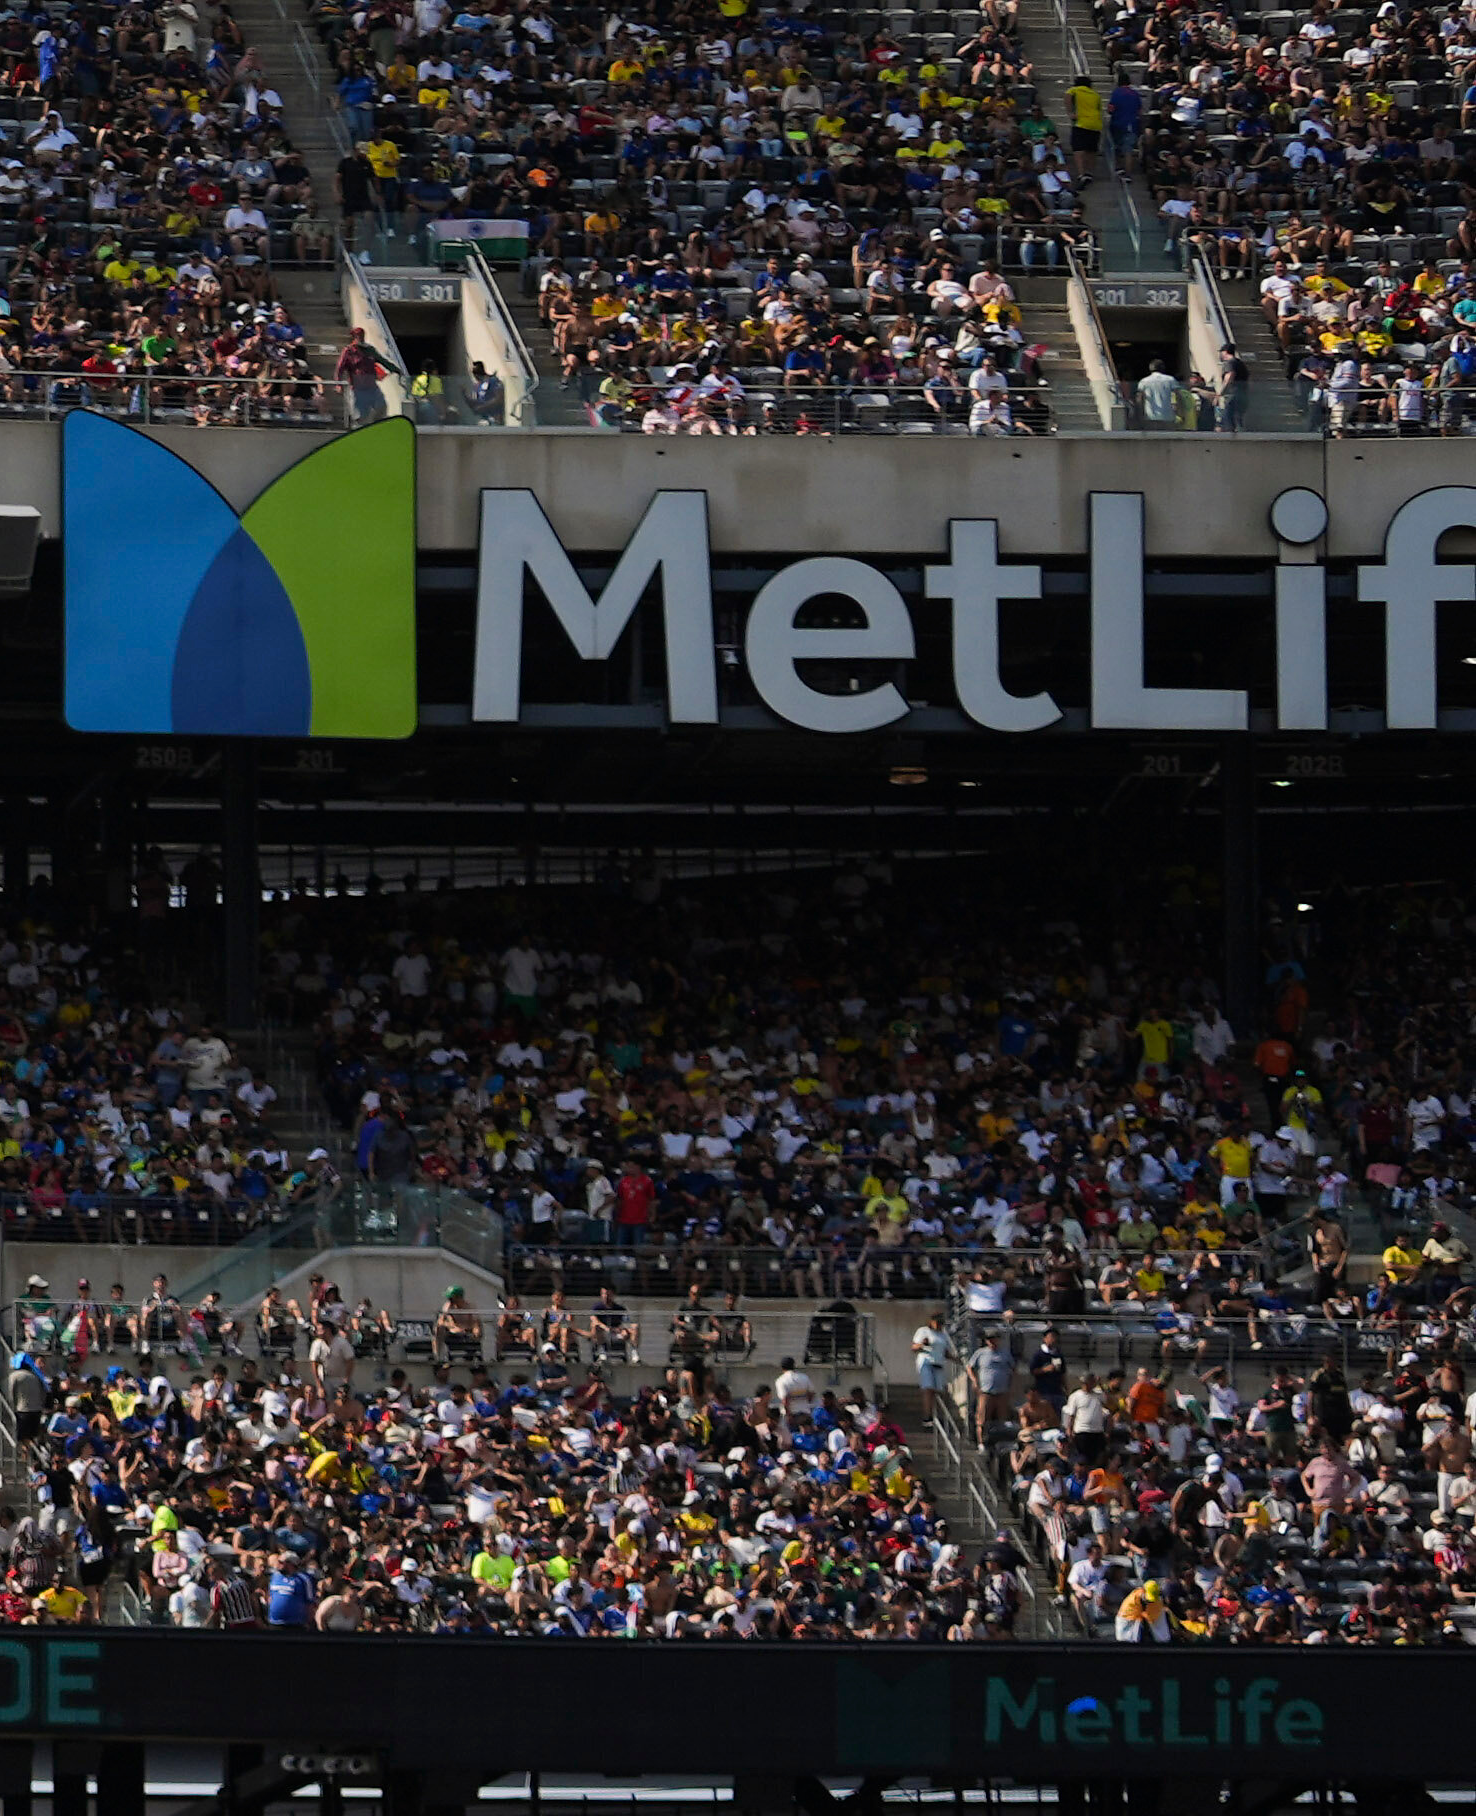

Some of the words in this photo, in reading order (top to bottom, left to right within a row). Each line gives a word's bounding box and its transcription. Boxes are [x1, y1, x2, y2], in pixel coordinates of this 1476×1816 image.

[419, 284, 454, 302] 301
[1094, 288, 1128, 308] 301
[984, 1676, 1324, 1746] MetLife
